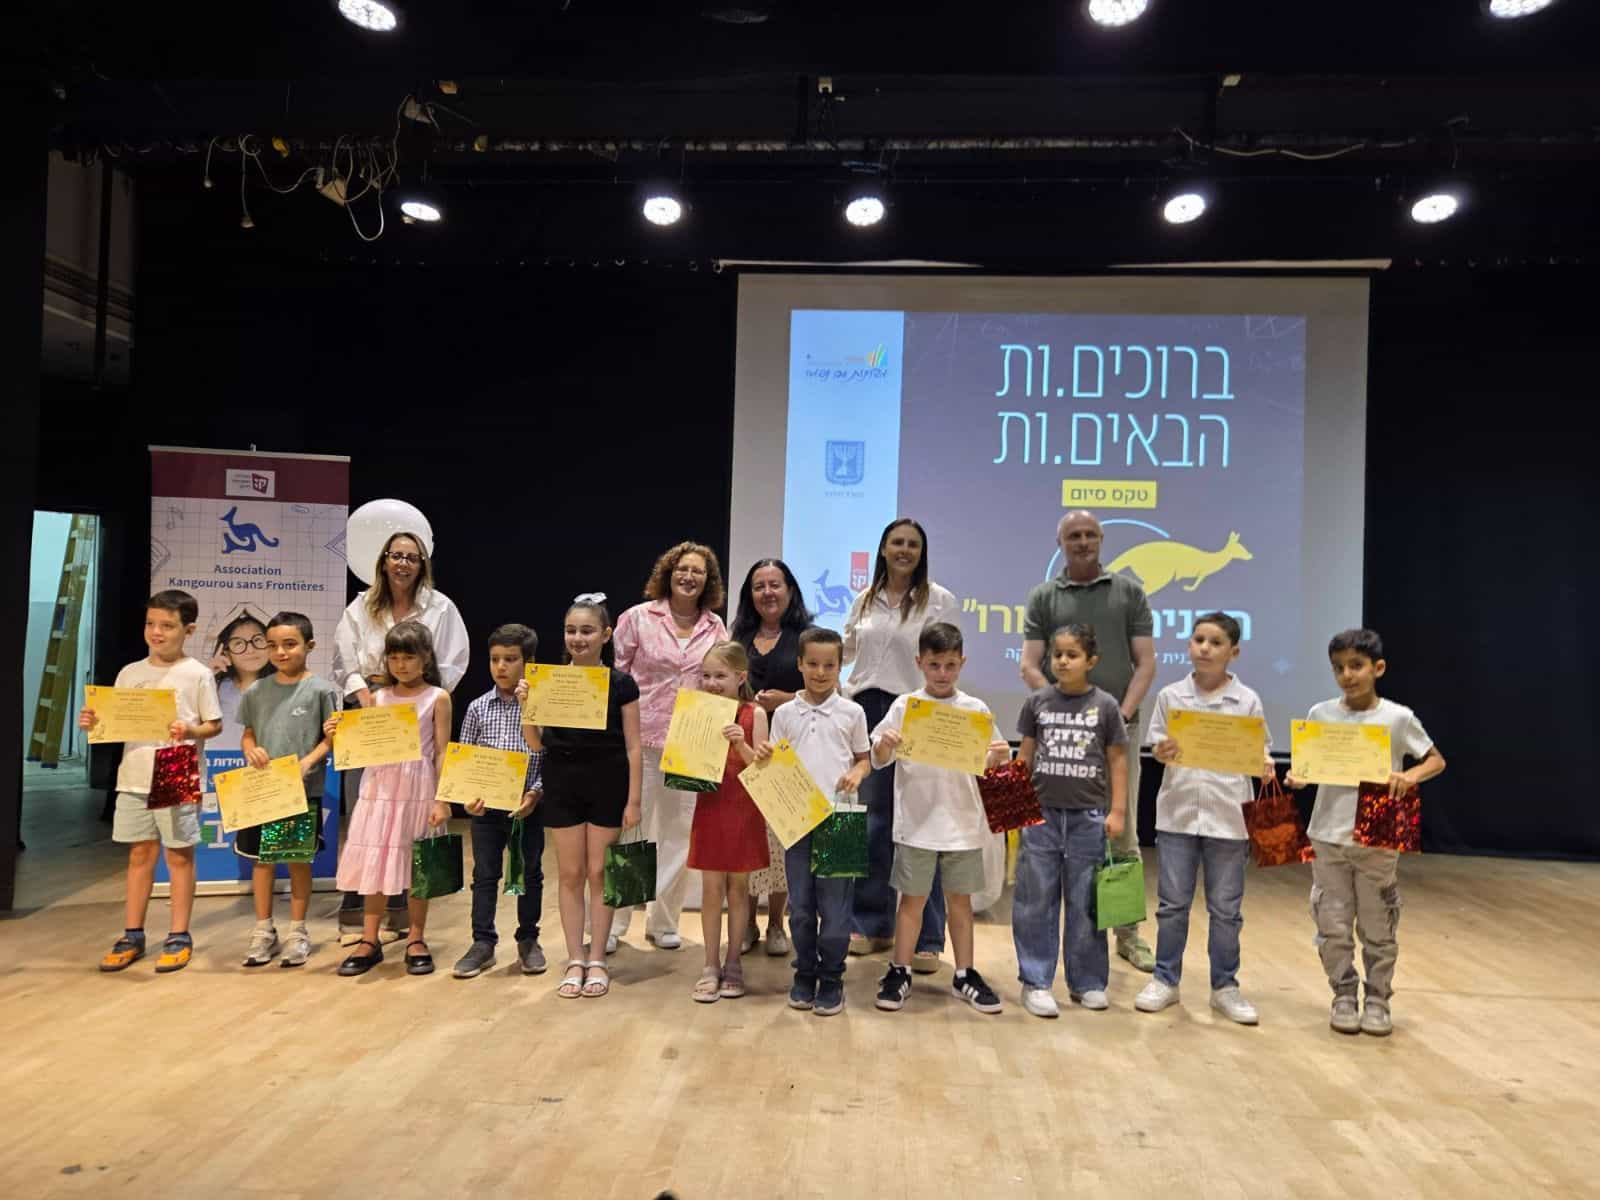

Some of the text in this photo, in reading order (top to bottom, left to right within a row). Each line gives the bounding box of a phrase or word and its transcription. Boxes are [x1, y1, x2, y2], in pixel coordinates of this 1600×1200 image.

[995, 344, 1234, 399] ברוכים.ות
[993, 411, 1229, 467] הבאים.ות
[1071, 488, 1149, 505] טקס סיום
[214, 564, 282, 576] Association
[168, 576, 325, 592] Kangourou sans Frontières
[1039, 711, 1099, 727] HELLO
[1043, 728, 1096, 744] KITTY
[1048, 745, 1086, 760] AND
